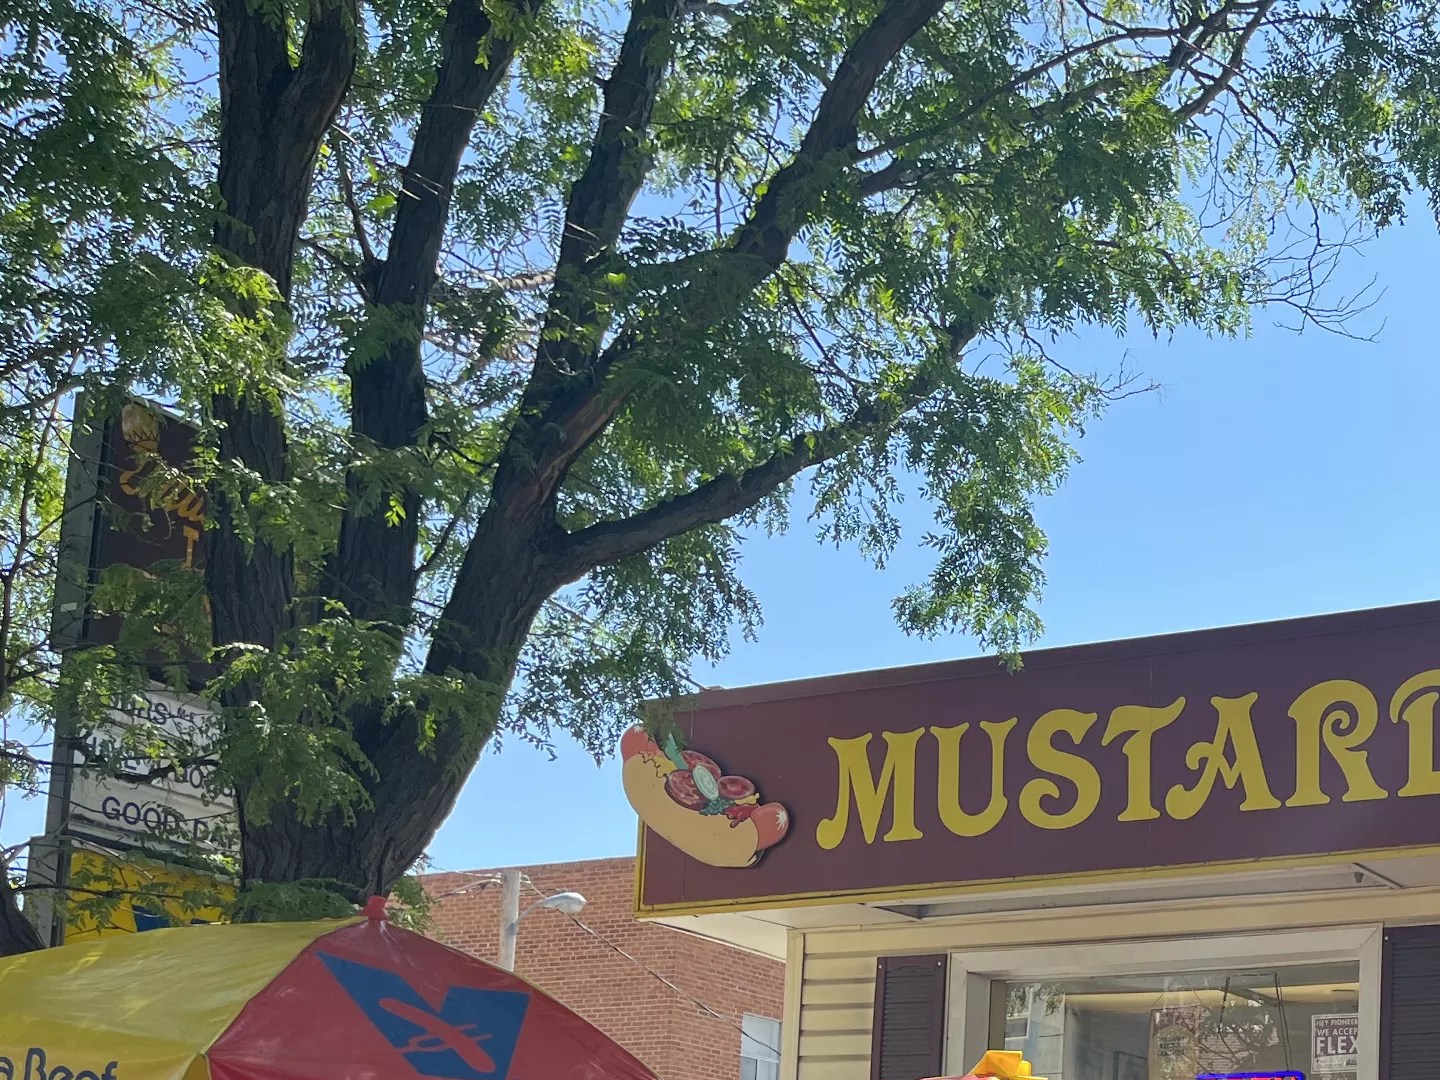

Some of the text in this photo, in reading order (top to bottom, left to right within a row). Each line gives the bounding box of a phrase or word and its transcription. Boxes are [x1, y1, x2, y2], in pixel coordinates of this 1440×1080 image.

[1317, 1027, 1358, 1036] WE ACCEP
[1316, 1035, 1358, 1056] FLEX
